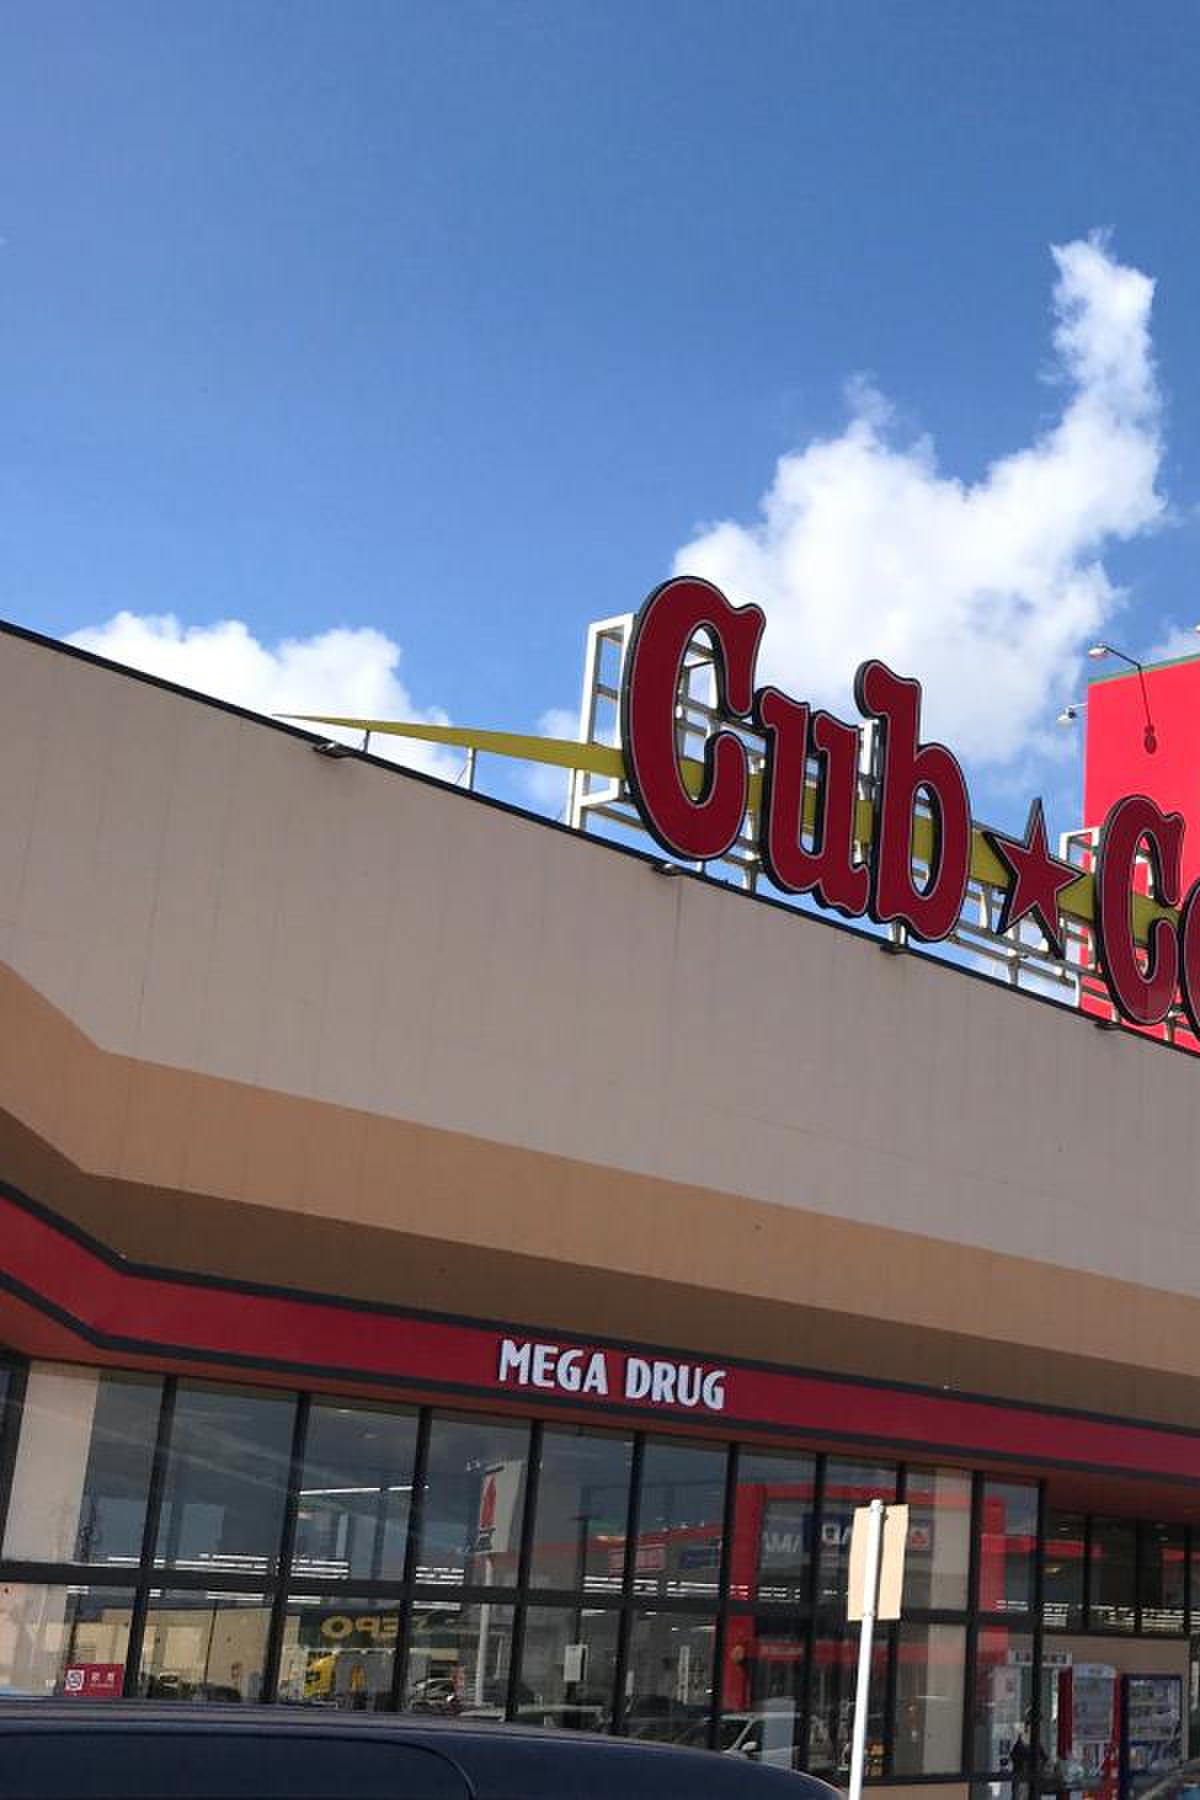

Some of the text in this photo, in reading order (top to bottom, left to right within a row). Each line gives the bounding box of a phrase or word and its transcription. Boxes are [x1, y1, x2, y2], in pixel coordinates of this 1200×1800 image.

[622, 576, 973, 942] Cub
[498, 1338, 727, 1411] MEGA DRUG
